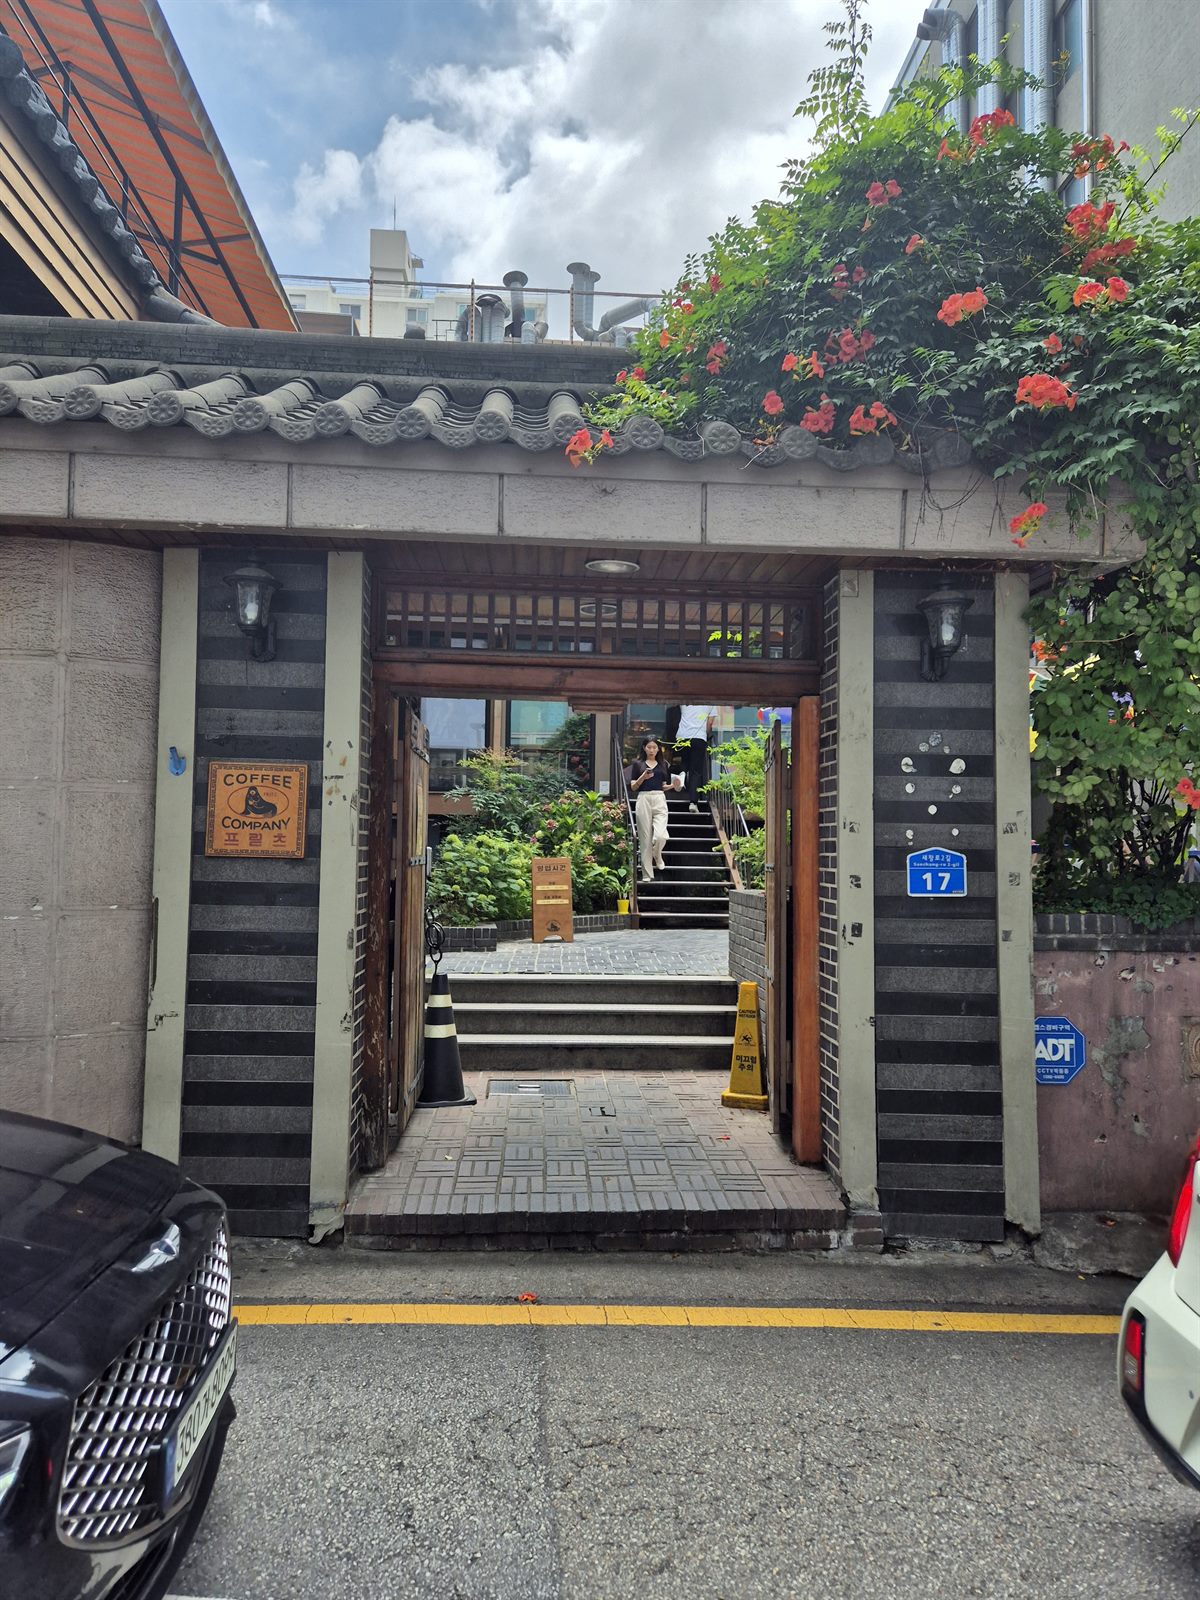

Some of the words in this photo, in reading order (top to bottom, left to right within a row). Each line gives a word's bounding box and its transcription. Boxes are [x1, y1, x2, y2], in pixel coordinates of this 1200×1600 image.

[223, 773, 292, 789] COFFEE
[221, 816, 291, 830] COMPANY
[537, 864, 566, 872] 영업시간
[922, 872, 951, 891] 17
[1035, 1038, 1075, 1062] ADT
[735, 1055, 757, 1064] 미끄럼
[738, 1063, 754, 1072] 주의
